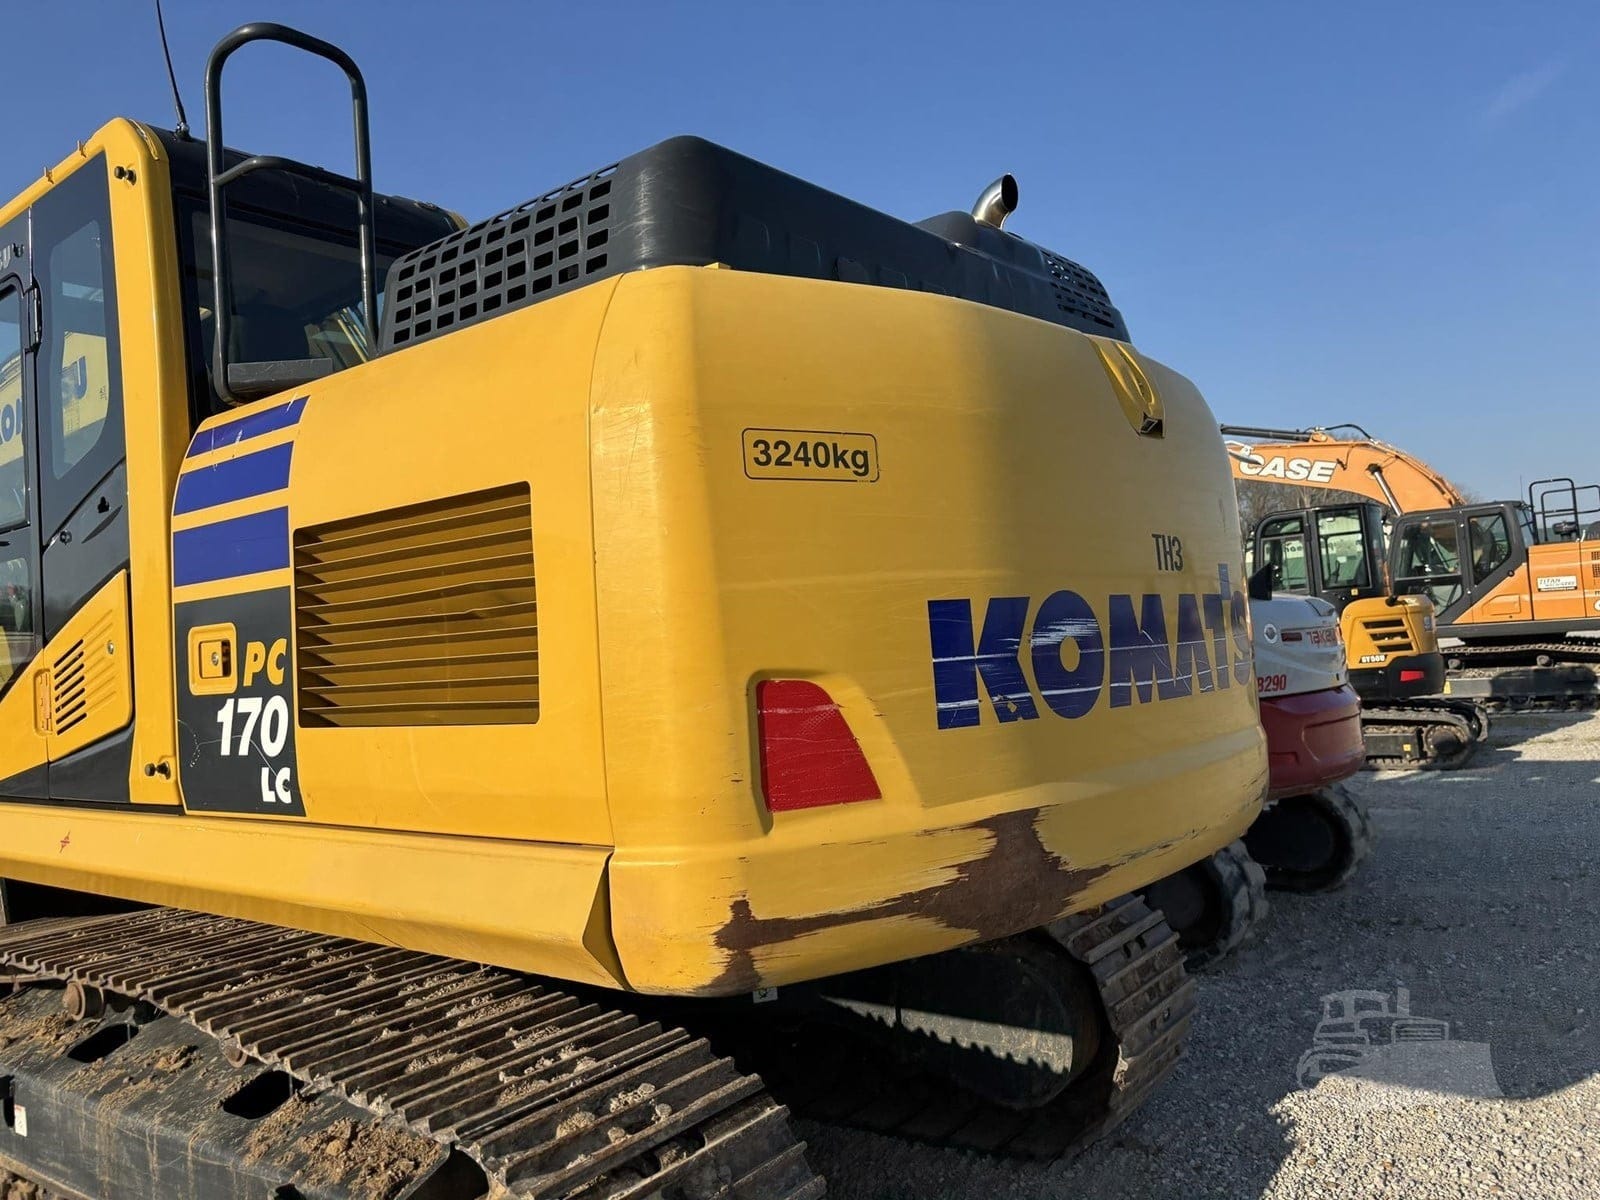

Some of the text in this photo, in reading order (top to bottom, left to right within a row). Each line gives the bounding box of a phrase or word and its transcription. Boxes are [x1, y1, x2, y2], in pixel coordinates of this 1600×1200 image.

[752, 439, 870, 477] 3240kg
[1239, 454, 1337, 483] CASE
[1152, 534, 1184, 572] TH3
[243, 638, 288, 687] PC
[216, 695, 289, 758] 170
[261, 767, 292, 804] LC
